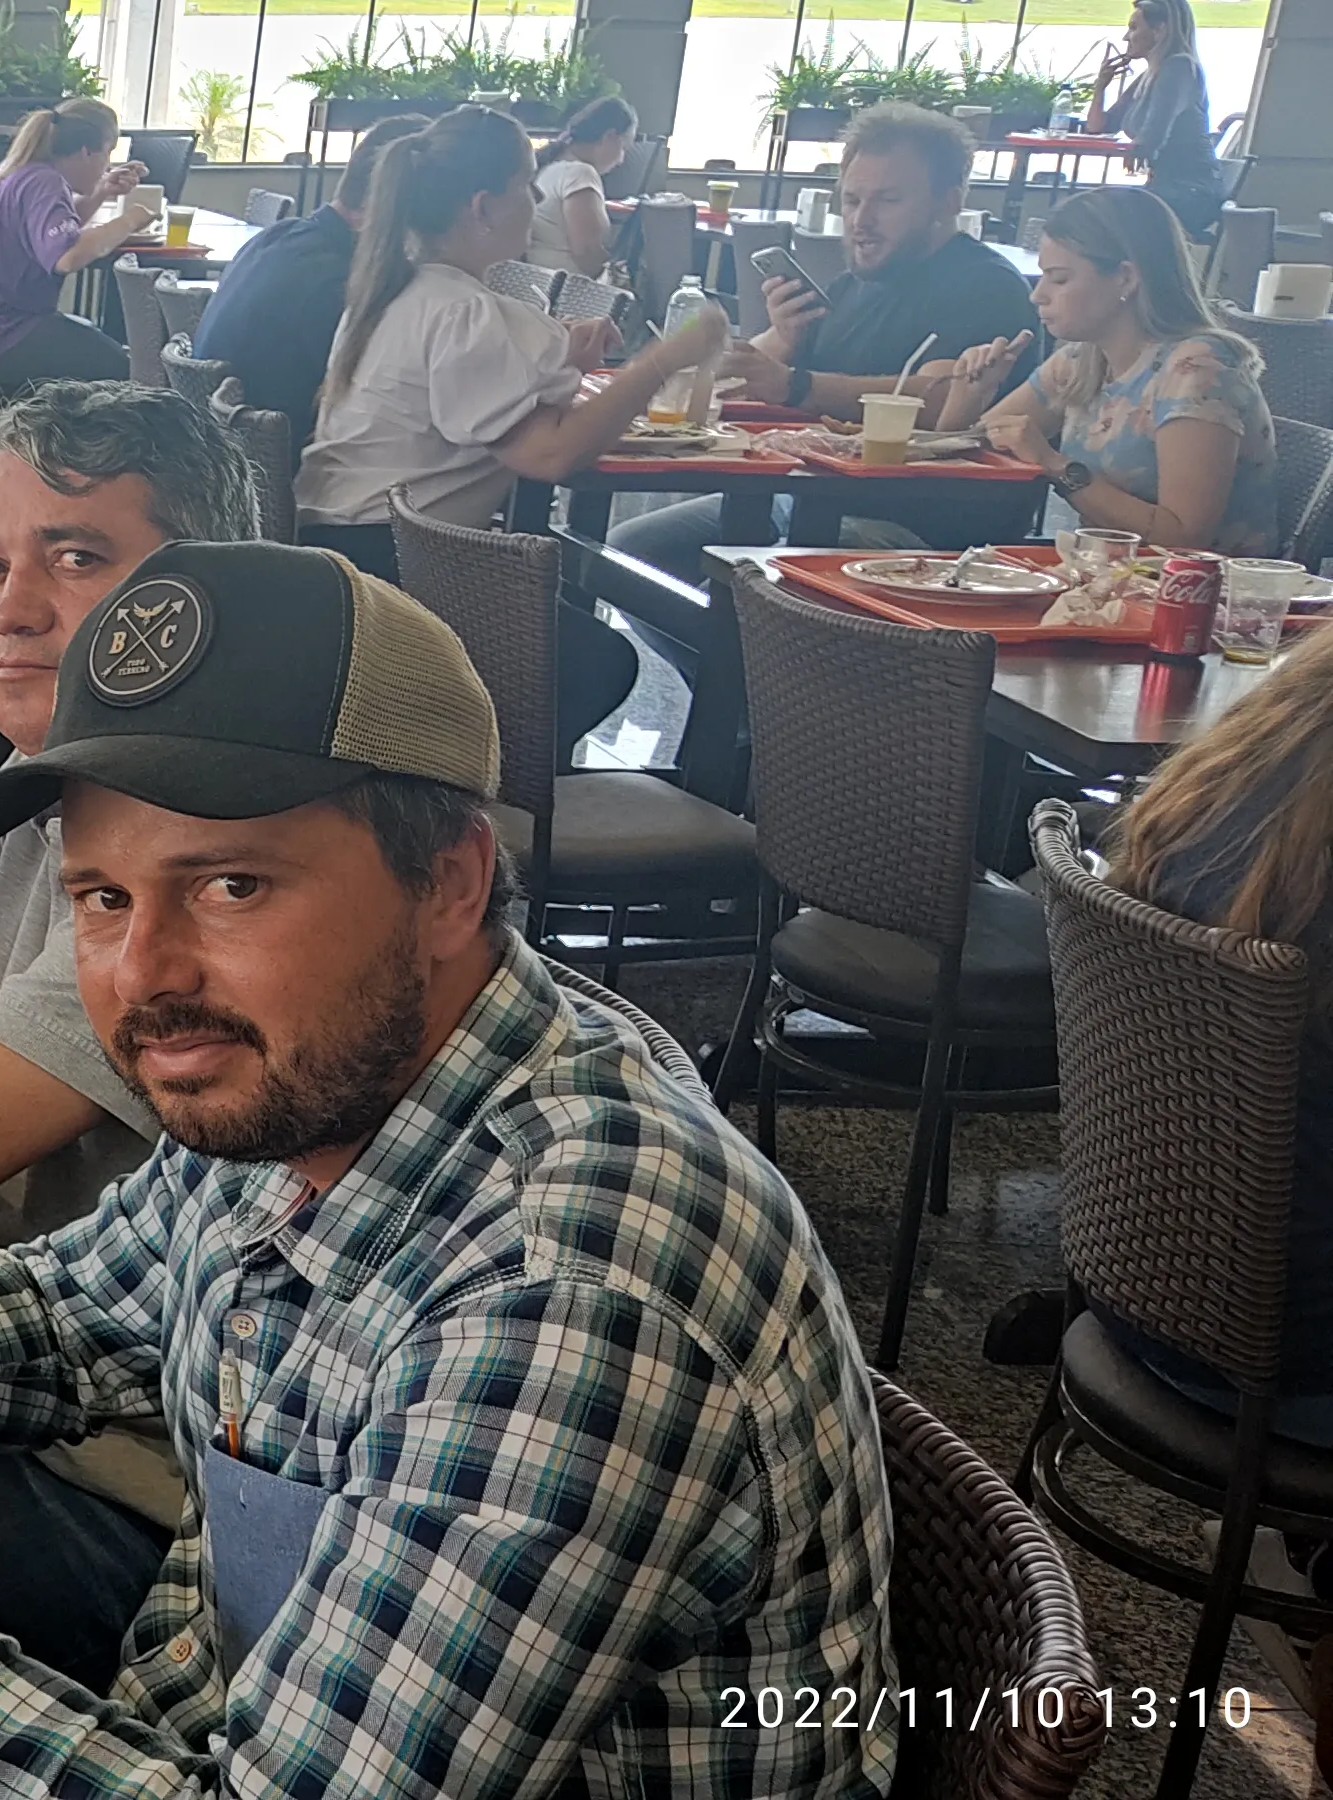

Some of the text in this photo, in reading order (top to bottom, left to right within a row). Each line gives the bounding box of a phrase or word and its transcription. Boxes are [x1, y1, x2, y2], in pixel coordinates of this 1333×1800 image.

[1161, 569, 1214, 604] Cola
[108, 624, 177, 654] B C
